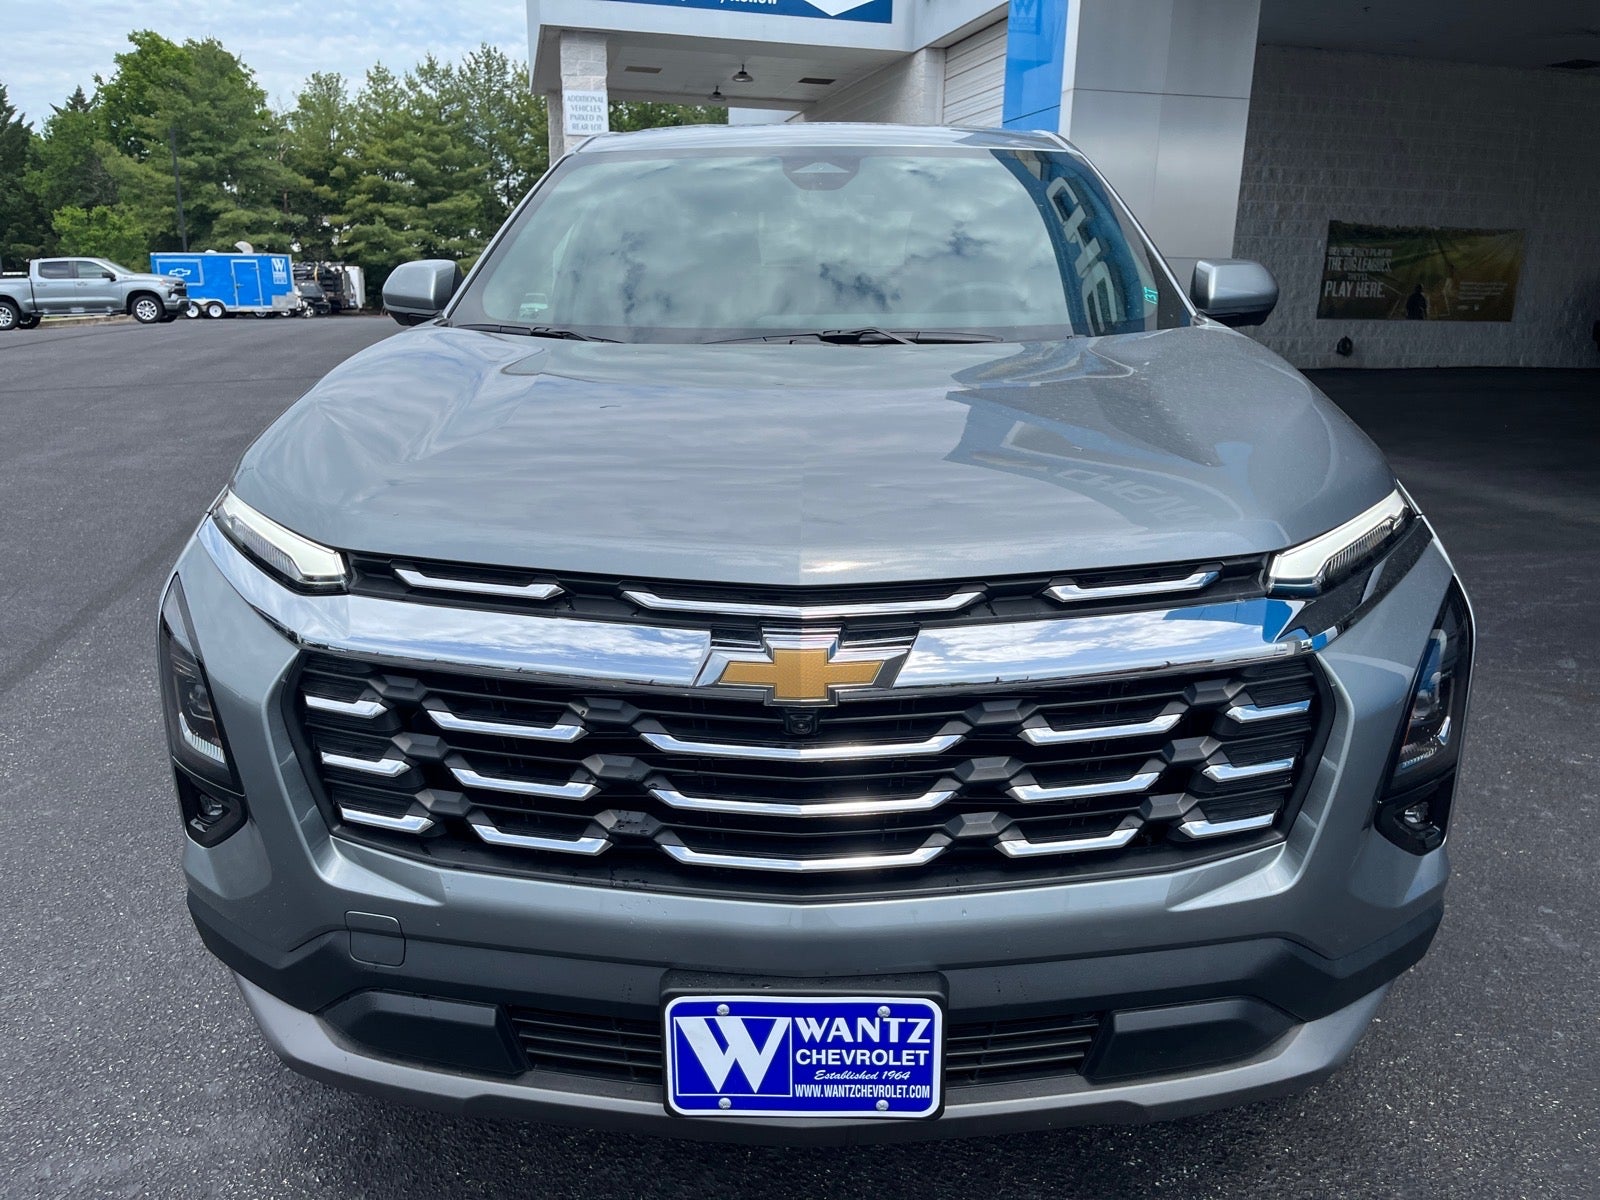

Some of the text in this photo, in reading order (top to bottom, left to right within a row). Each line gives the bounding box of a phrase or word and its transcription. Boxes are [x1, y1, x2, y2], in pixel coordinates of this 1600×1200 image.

[567, 95, 603, 103] ADDITIONAL
[1328, 256, 1343, 271] THE
[1325, 281, 1353, 298] PLAY
[794, 1016, 931, 1044] WANTZ
[675, 1018, 791, 1094] W
[795, 1048, 930, 1066] CHEVROLET
[814, 1069, 911, 1081] Established 1964
[794, 1084, 930, 1099] WWW.WANTZCHEVROLET.COM
